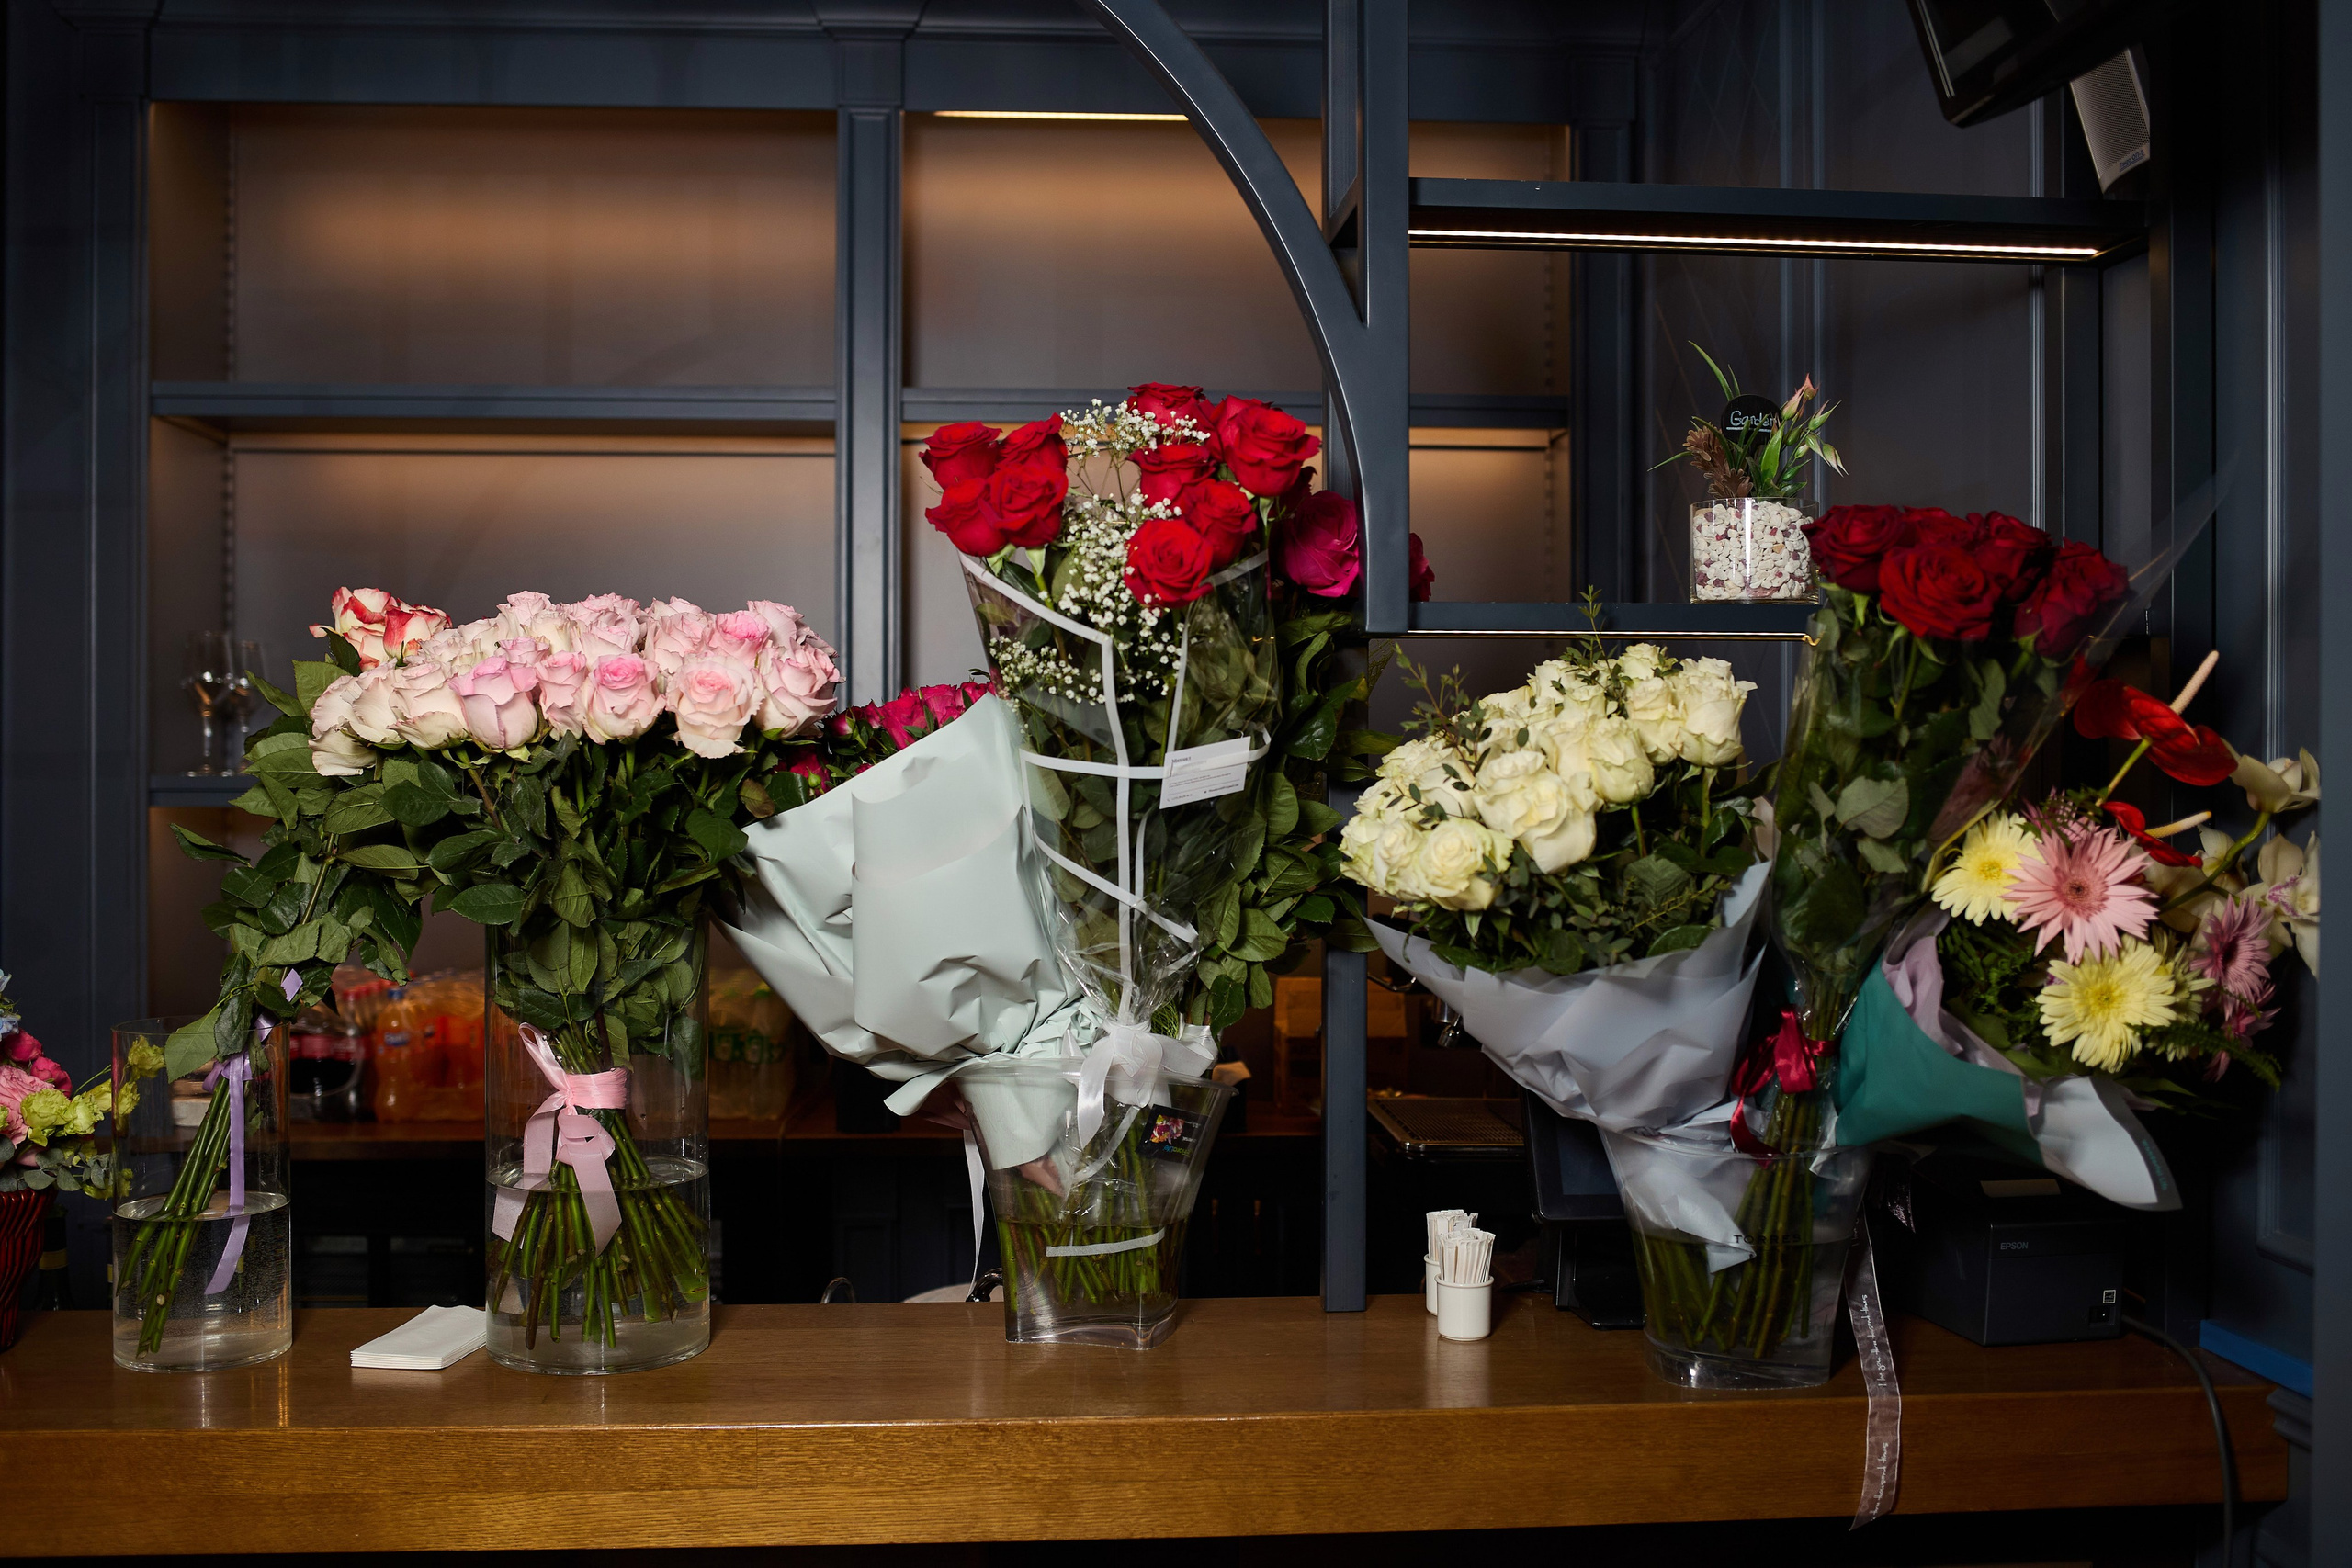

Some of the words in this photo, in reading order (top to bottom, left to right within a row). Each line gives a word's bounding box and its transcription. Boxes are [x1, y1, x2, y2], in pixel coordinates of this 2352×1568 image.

[1730, 410, 1777, 427] Garden
[1734, 1234, 1801, 1244] TORRES
[2000, 1241, 2029, 1250] EPSON
[1876, 1357, 1886, 1371] you
